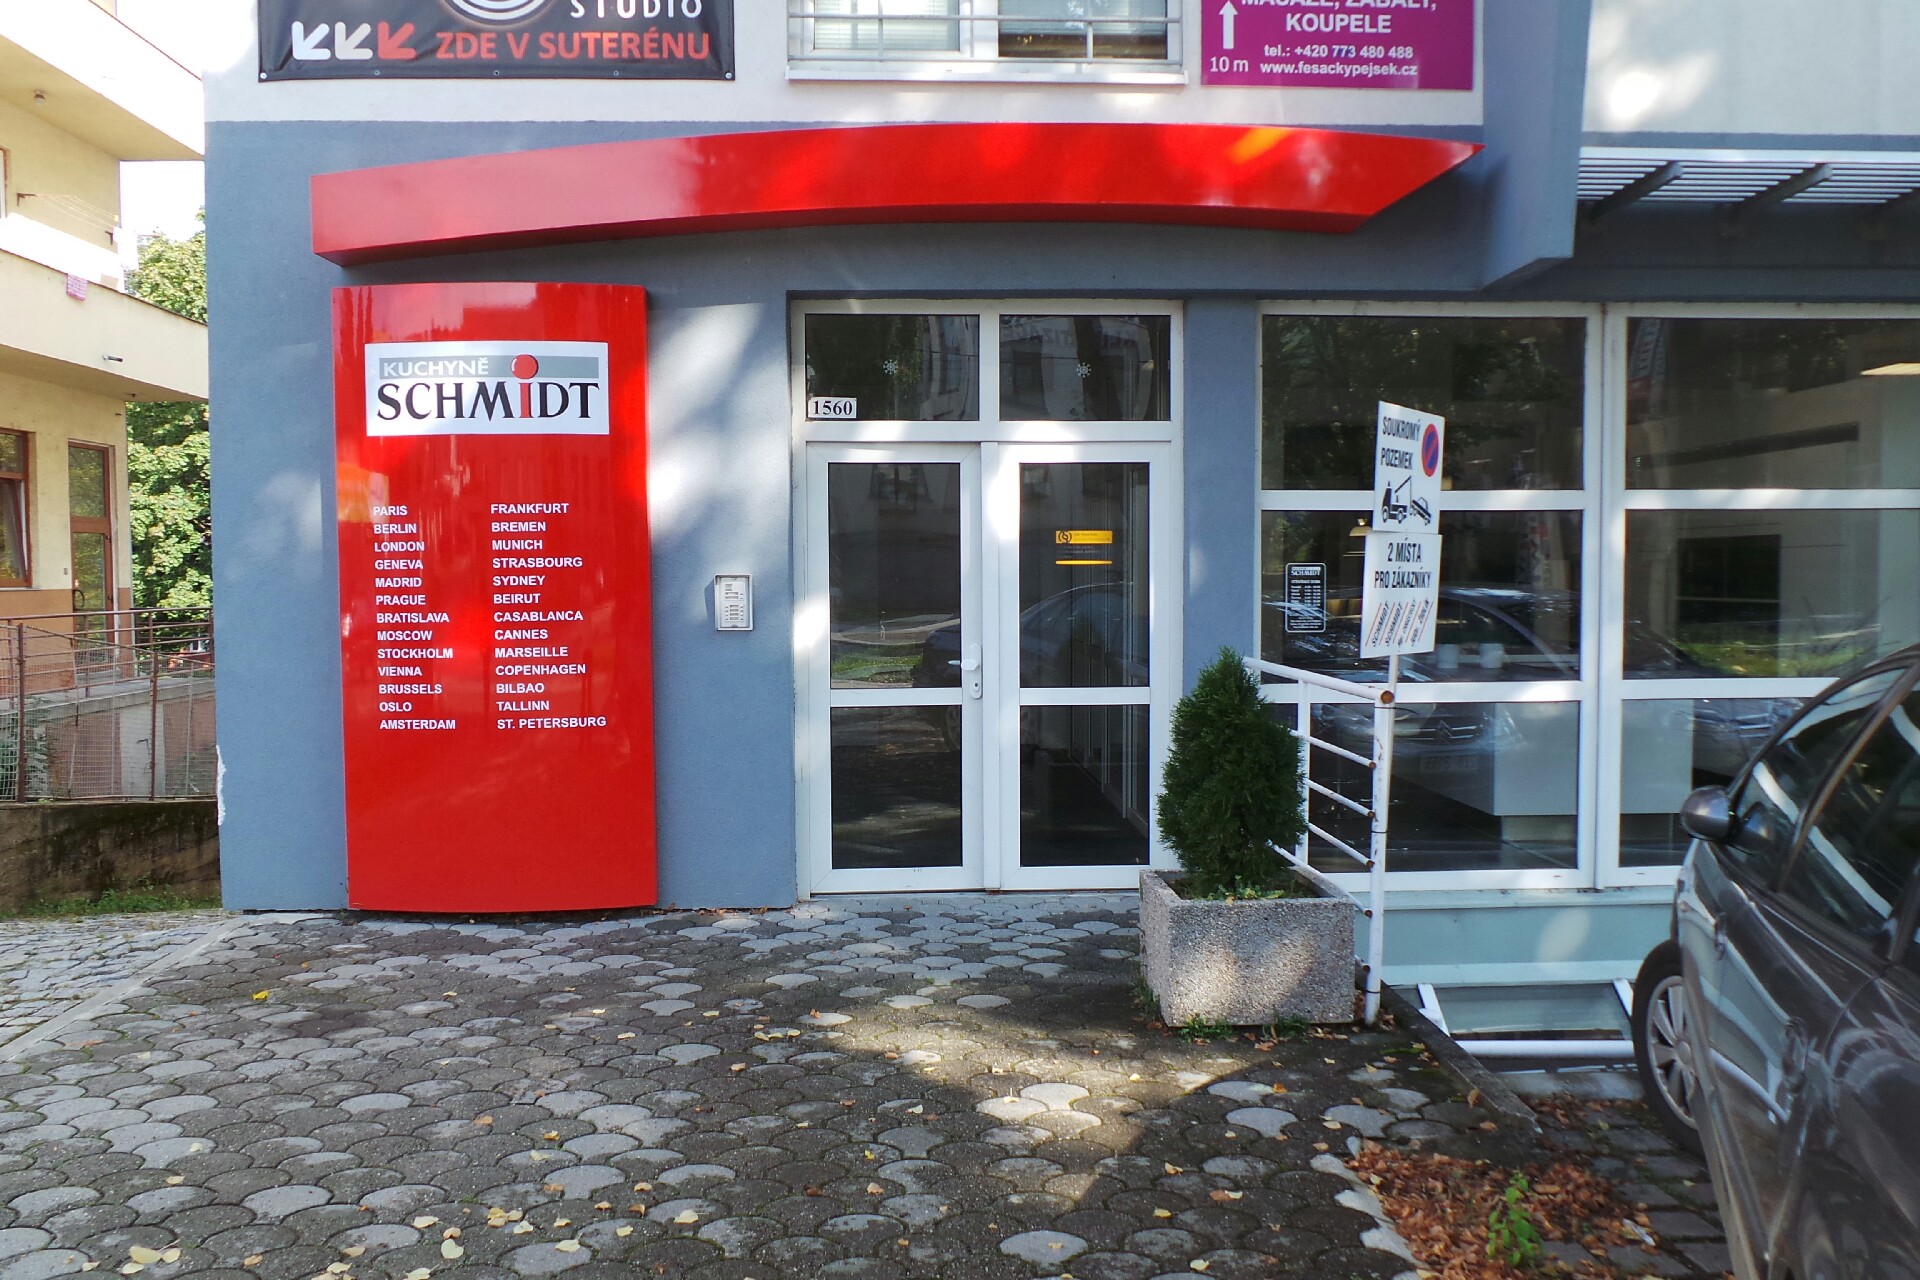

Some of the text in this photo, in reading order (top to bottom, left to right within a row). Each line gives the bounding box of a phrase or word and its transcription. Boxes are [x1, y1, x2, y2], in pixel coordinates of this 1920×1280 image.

[1286, 13, 1392, 33] KOUPELE
[436, 26, 710, 60] ZDE V SUTERÉNU
[1264, 44, 1414, 59] tel.: +420 773 480 488
[1210, 56, 1248, 73] 10 m
[1260, 62, 1418, 78] www.fesackypejsek.cz
[384, 356, 488, 377] KUCHYNĚ
[377, 354, 600, 421] SCHMIDT
[813, 400, 853, 415] 1560
[1383, 416, 1420, 442] SOUKROMÝ
[1381, 448, 1414, 470] POZEMEK
[373, 505, 408, 516] PARIS
[491, 503, 569, 514] FRANKFURT
[374, 523, 417, 534] BERLIN
[492, 521, 546, 532] BREMEN
[375, 541, 424, 552] LONDON
[492, 539, 543, 550] MUNICH
[1388, 537, 1421, 562] 2 MÍSTA
[375, 559, 423, 570] GENEVA
[492, 557, 582, 567] STRASBOURG
[375, 577, 422, 587] MADRID
[493, 574, 545, 585] SYDNEY
[1374, 566, 1431, 588] PRO ZÁKAZNÍKY
[376, 594, 425, 605] PRAGUE
[494, 592, 540, 603] BEIRUT
[376, 612, 450, 623] BRATISLAVA
[494, 610, 583, 621] CASABLANCA
[377, 630, 432, 641] MOSCOW
[494, 628, 548, 639] CANNES
[378, 648, 453, 659] STOCKHOLM
[495, 646, 568, 657] MARSEILLE
[378, 666, 422, 676] VIENNA
[496, 664, 586, 675] COPENHAGEN
[379, 684, 442, 694] BRUSSELS
[496, 682, 544, 692] BILBAO
[380, 701, 412, 712] OSLO
[496, 700, 550, 710] TALLINN
[380, 719, 456, 730] AMSTERDAM
[497, 717, 606, 728] ST. PETERSBURG
